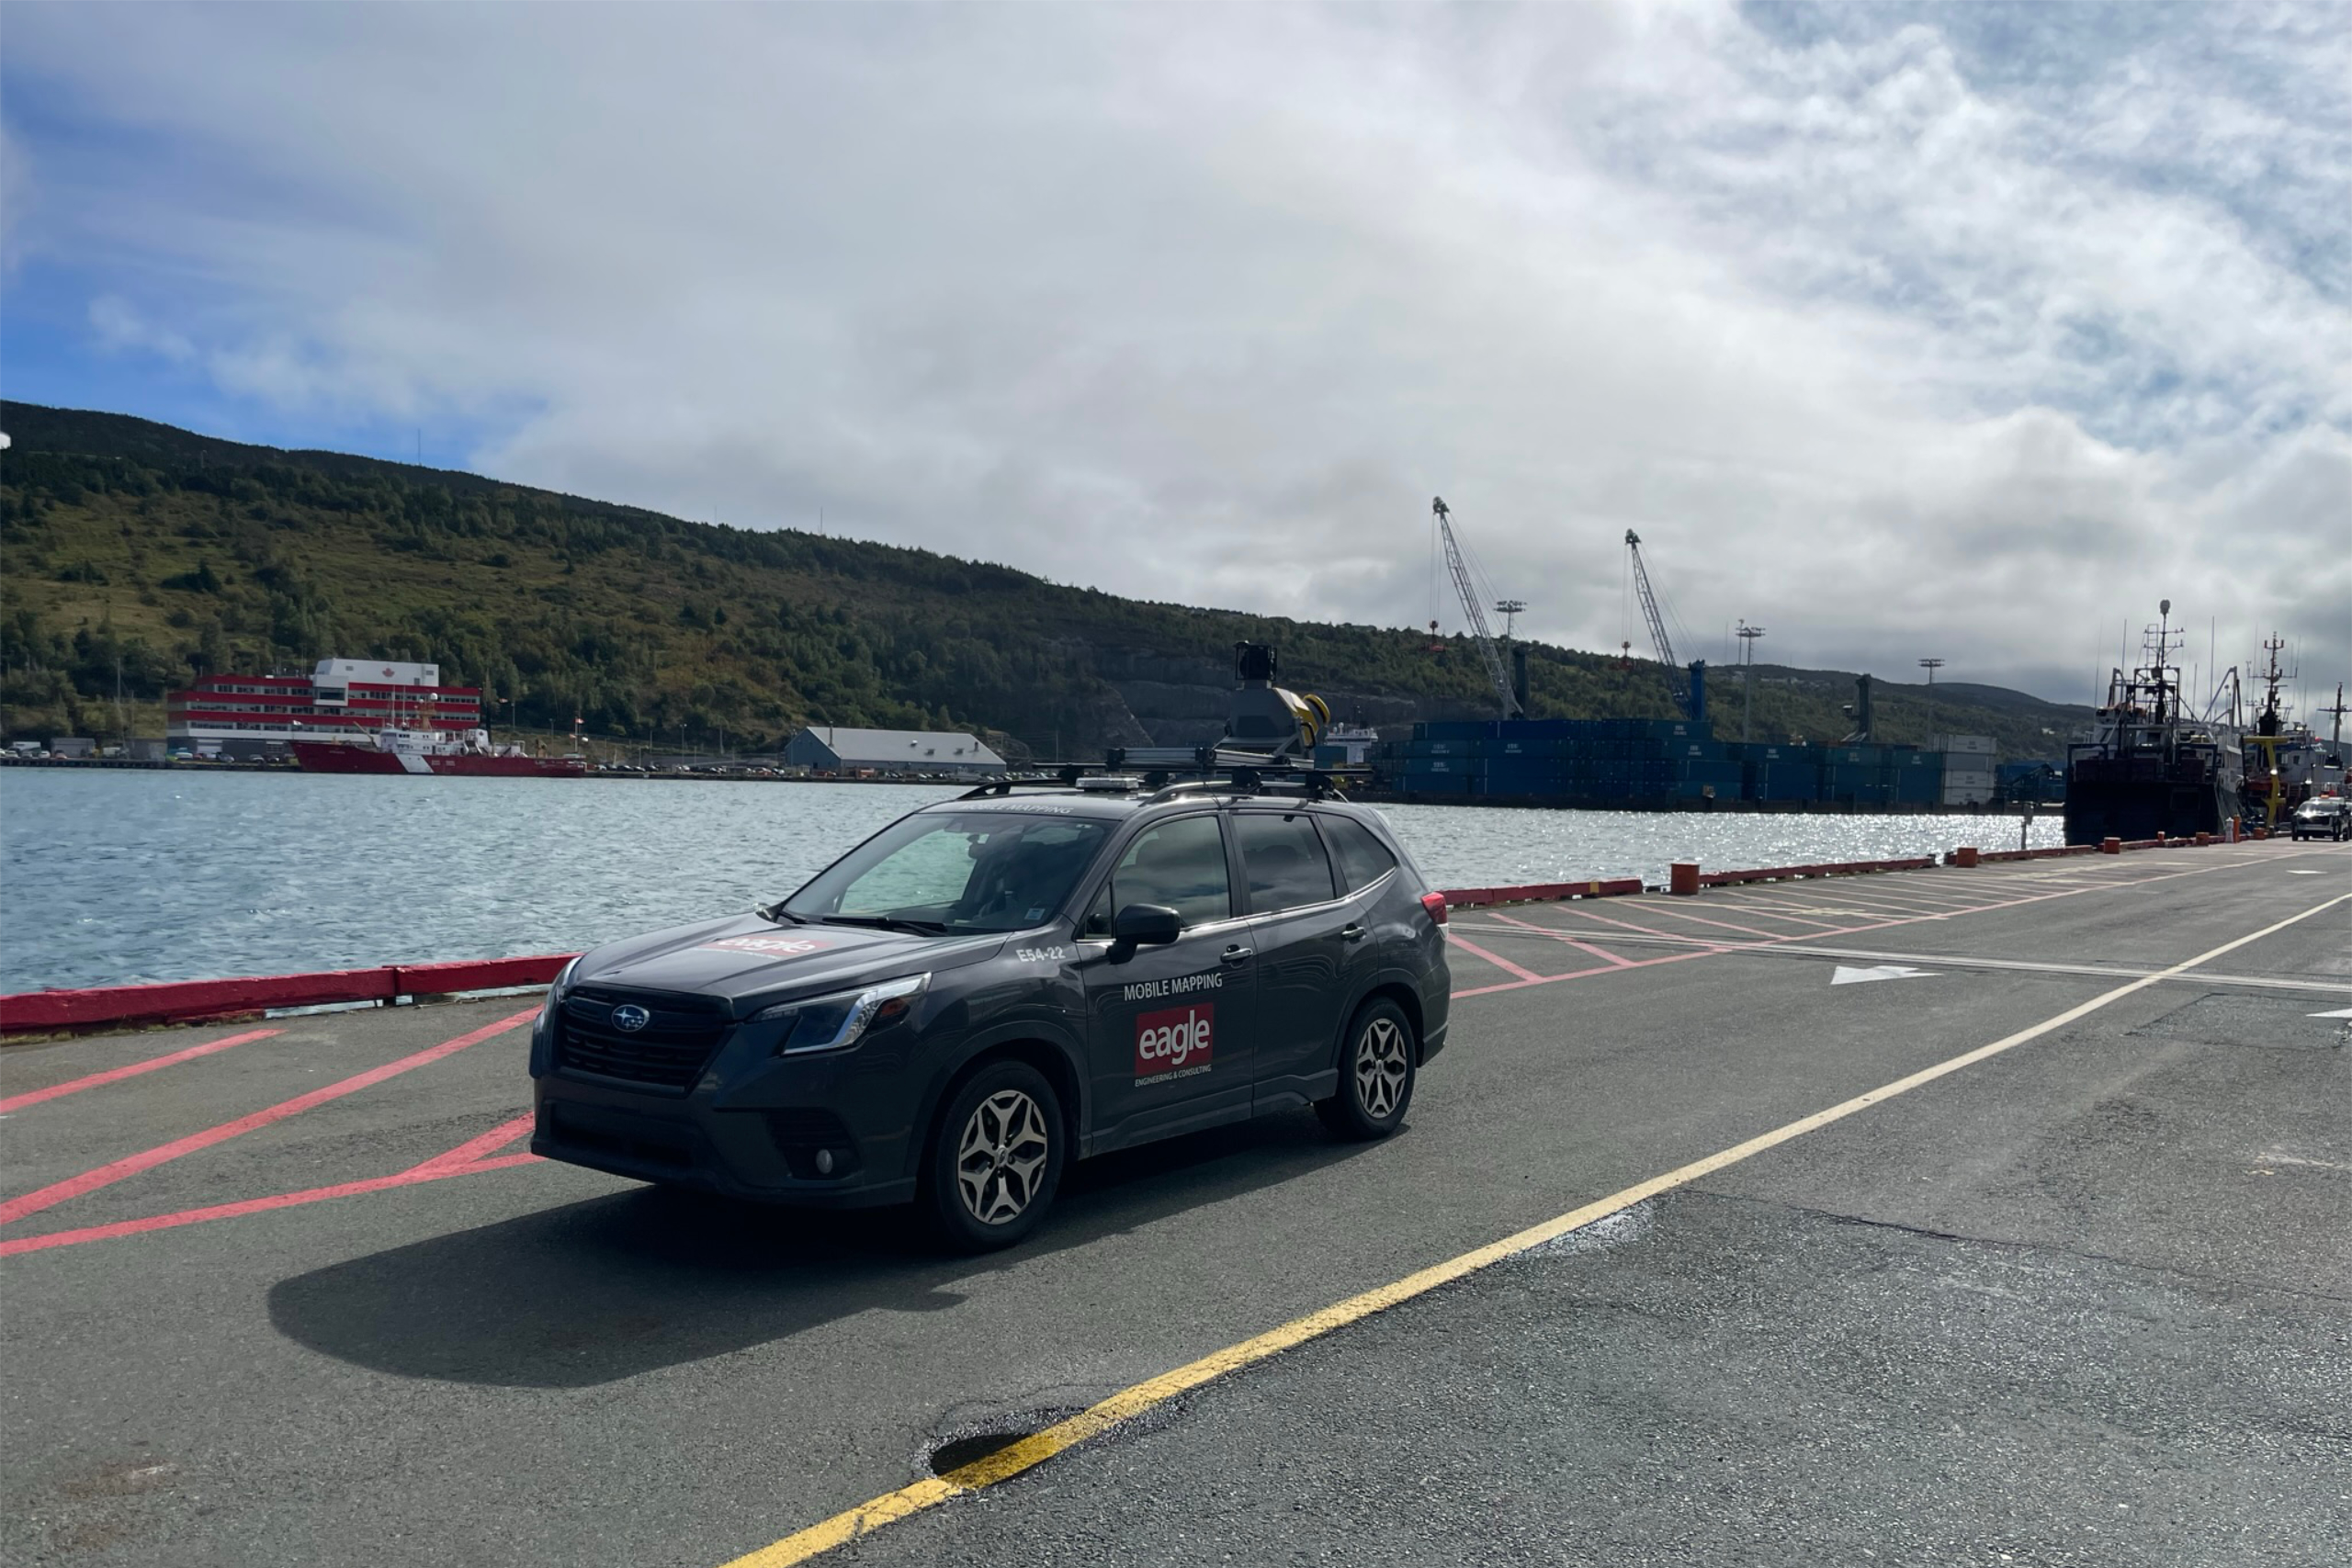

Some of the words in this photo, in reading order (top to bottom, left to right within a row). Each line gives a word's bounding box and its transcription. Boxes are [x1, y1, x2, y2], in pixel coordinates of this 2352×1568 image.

[1006, 804, 1074, 814] MAPPING
[1015, 945, 1067, 963] E54-22
[1124, 979, 1170, 1002] MOBILE
[1171, 972, 1223, 995] MAPPING
[1139, 1009, 1210, 1066] eagle
[1134, 1071, 1173, 1088] ENGINEERING
[1172, 1070, 1178, 1079] &
[1178, 1064, 1212, 1078] CONSULTING
